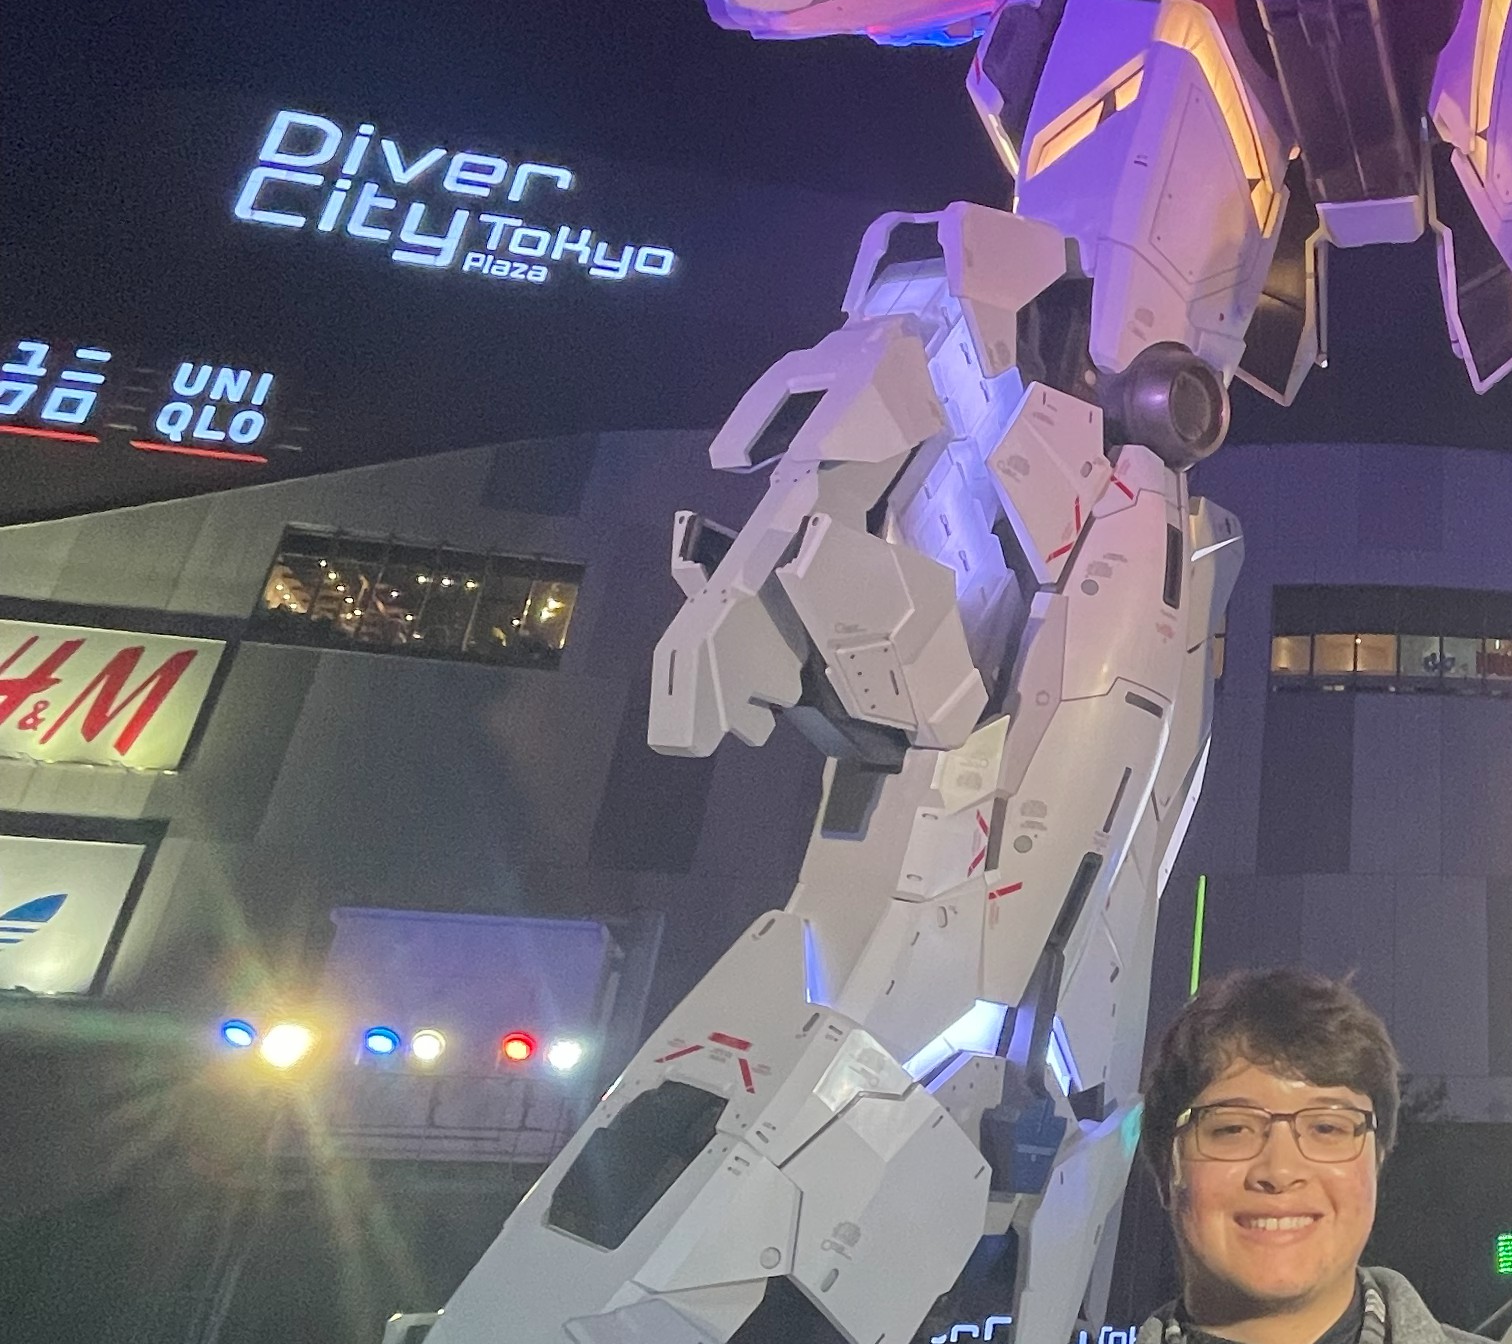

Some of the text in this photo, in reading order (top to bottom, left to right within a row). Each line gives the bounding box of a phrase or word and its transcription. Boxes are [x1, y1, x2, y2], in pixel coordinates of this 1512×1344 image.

[258, 109, 577, 202] Diver
[232, 164, 470, 268] City
[461, 250, 549, 284] Plaza
[172, 362, 274, 406] UNI
[155, 401, 266, 445] QLO
